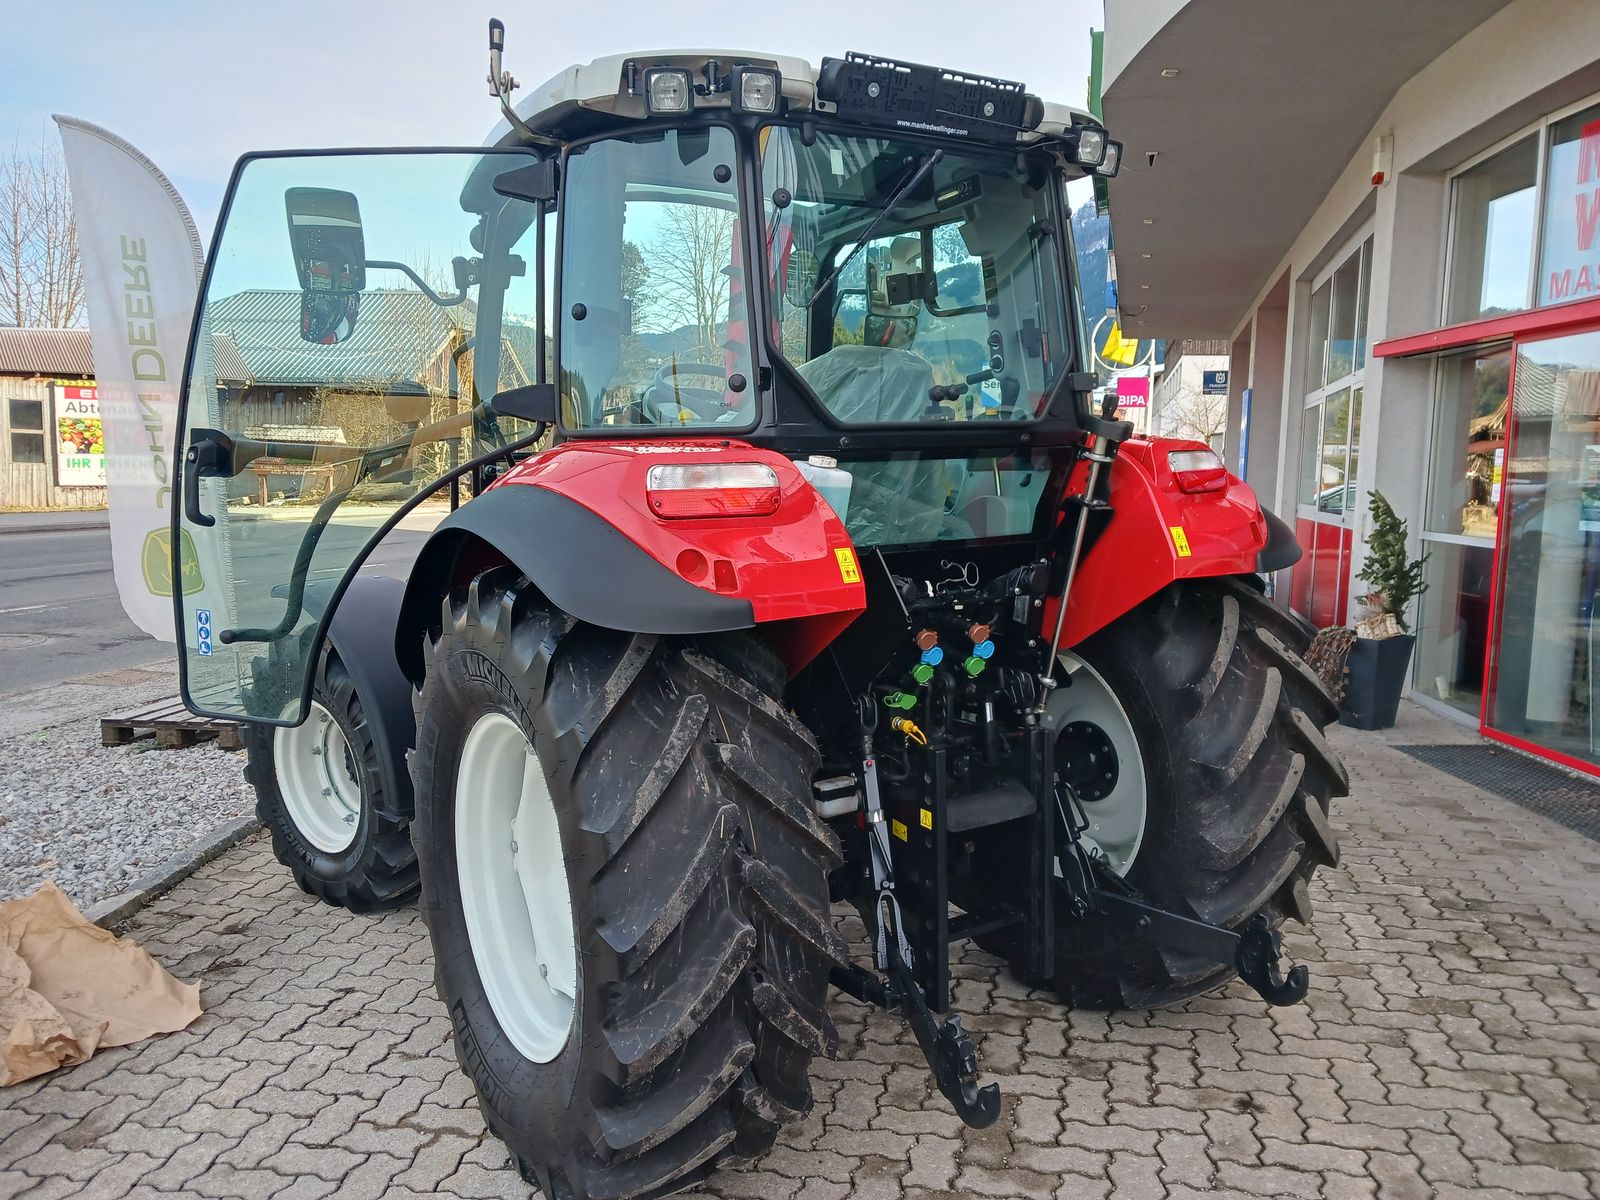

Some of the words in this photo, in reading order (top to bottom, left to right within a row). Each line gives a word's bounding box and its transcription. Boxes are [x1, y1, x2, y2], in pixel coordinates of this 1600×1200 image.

[897, 119, 969, 136] www.manfredwallinger.com
[1118, 394, 1146, 406] BIPA
[66, 458, 91, 469] IHR
